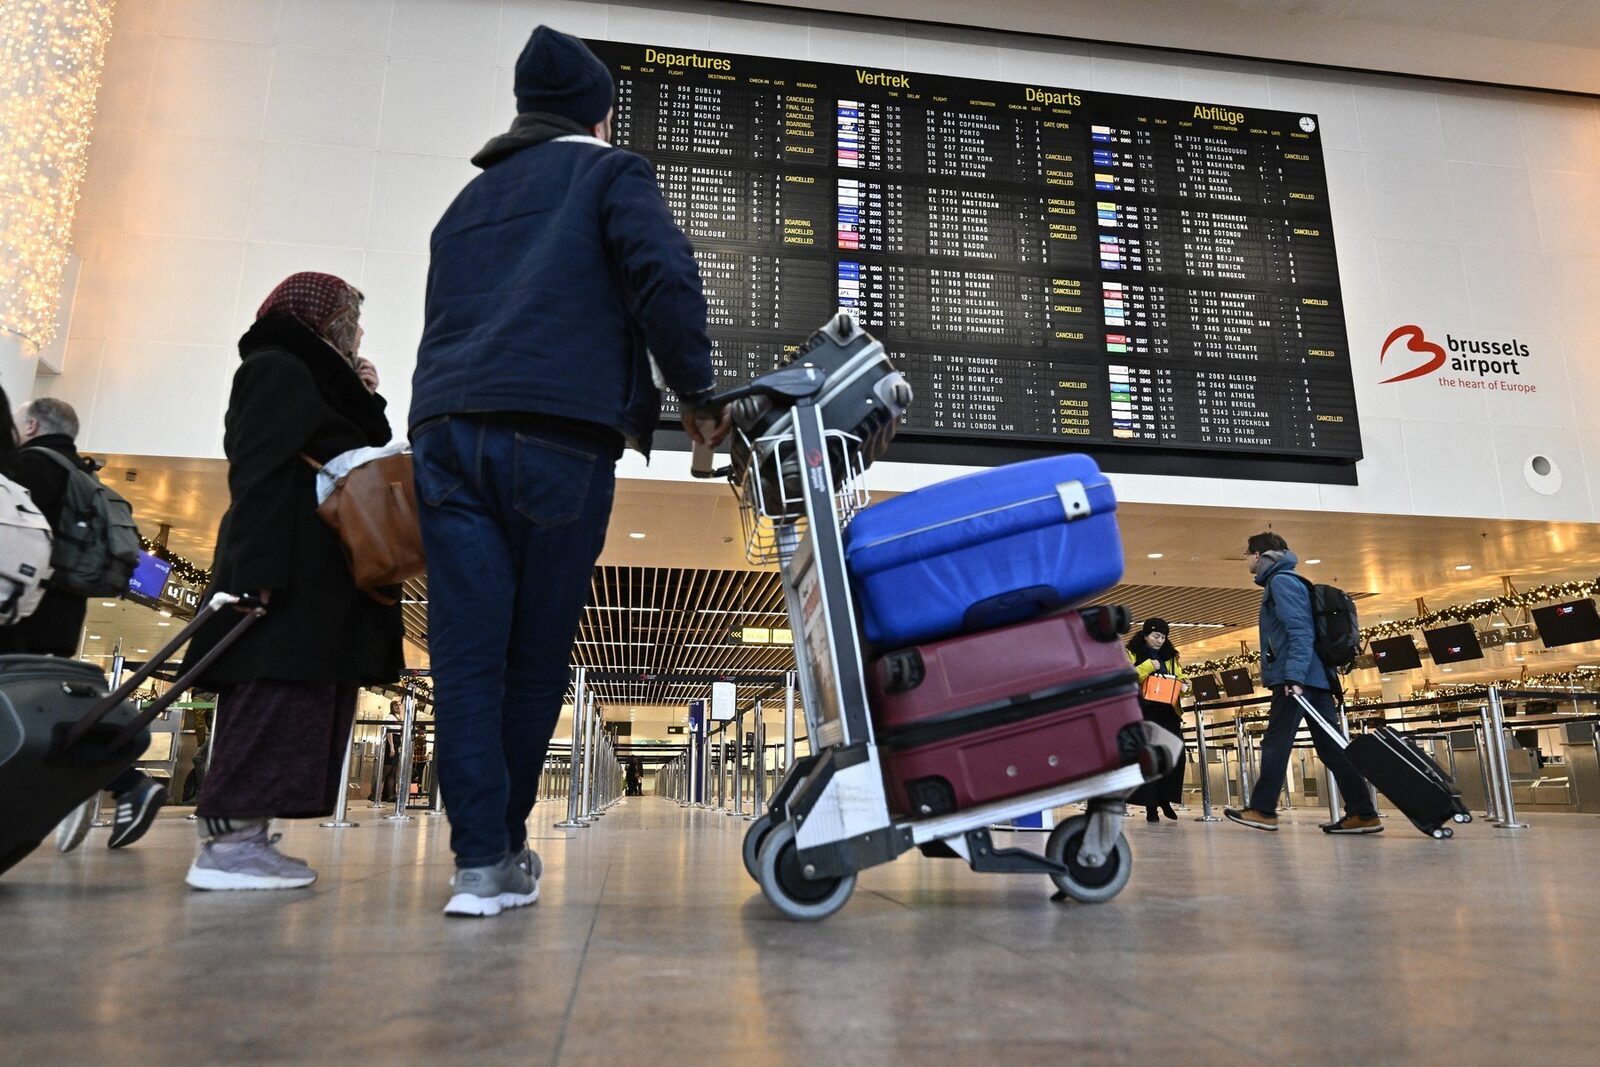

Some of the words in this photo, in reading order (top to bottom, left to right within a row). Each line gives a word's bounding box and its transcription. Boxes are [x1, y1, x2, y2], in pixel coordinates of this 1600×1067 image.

[646, 49, 731, 71] Departures
[856, 70, 910, 88] Vertrek
[695, 87, 721, 95] DUBLIN
[1026, 88, 1081, 106] Départs
[694, 112, 720, 120] MADRID
[786, 112, 814, 120] CANCELLED
[1194, 105, 1244, 125] Abflüge
[959, 121, 1000, 130] COPENHAGEN
[694, 129, 729, 138] TENERIFE
[785, 129, 814, 137] CANCELLED
[694, 146, 732, 155] FRANKFURT
[785, 146, 814, 154] CANCELLED
[1284, 153, 1309, 161] CANCELLED
[1207, 162, 1245, 170] WASHINGTON
[692, 168, 732, 177] MARSEILLE
[1046, 170, 1073, 178] CANCELLED
[692, 176, 723, 184] HAMBURG
[1210, 193, 1241, 201] KINSHASA
[1289, 192, 1314, 200] CANCELLED
[691, 202, 718, 210] LONDON
[962, 200, 999, 208] AMSTERDAM
[1048, 207, 1075, 215] CANCELLED
[1048, 199, 1075, 207] CANCELLED
[691, 211, 718, 219] LONDON
[1212, 213, 1247, 222] BUCHAREST
[963, 216, 987, 224] ATHENS
[1049, 223, 1076, 231] CANCELLED
[691, 229, 726, 238] TOULOUSE
[1213, 222, 1248, 230] BARCELONA
[1294, 228, 1319, 236] CANCELLED
[963, 233, 988, 241] LISBON
[1050, 232, 1077, 240] CANCELLED
[964, 250, 997, 259] SHANGHAI
[1216, 255, 1244, 263] BEIJING
[965, 272, 994, 280] BOLOGNA
[1053, 279, 1080, 287] CANCELLED
[1218, 271, 1246, 280] BANGKOK
[965, 281, 990, 289] NEWARK
[1053, 288, 1080, 296] CANCELLED
[1221, 292, 1256, 300] FRANKFURT
[966, 298, 999, 307] HELSINKI
[1054, 305, 1082, 313] CANCELLED
[966, 307, 1004, 316] SINGAPORE
[1222, 309, 1254, 317] PRISTINA
[966, 316, 1004, 325] BUCHAREST
[1224, 318, 1254, 326] ISTANBUL
[967, 325, 1004, 334] FRANKFURT
[1056, 331, 1083, 339] CANCELLED
[1224, 326, 1251, 334] ALGIERS
[1226, 344, 1257, 352] ALICANTE
[1447, 334, 1529, 357] brussels
[1227, 352, 1258, 360] TENERIFE
[968, 357, 998, 365] YAOUNDE
[1452, 354, 1519, 376] airport
[968, 366, 994, 374] DOUALA
[1229, 374, 1257, 382] ALGIERS
[1059, 380, 1087, 389] CANCELLED
[1229, 383, 1254, 391] MUNICH
[1439, 378, 1456, 387] the
[1459, 379, 1486, 389] heart
[1489, 380, 1499, 389] of
[1501, 381, 1536, 393] Europe
[970, 394, 1003, 402] ISTANBUL
[1060, 399, 1088, 407] CANCELLED
[1233, 409, 1269, 418] LJUBLJANA
[1061, 418, 1089, 426] CANCELLED
[1233, 418, 1270, 427] STOCKHOLM
[971, 422, 996, 430] LONDON
[1062, 427, 1090, 435] CANCELLED
[1236, 436, 1271, 445] FRANKFURT
